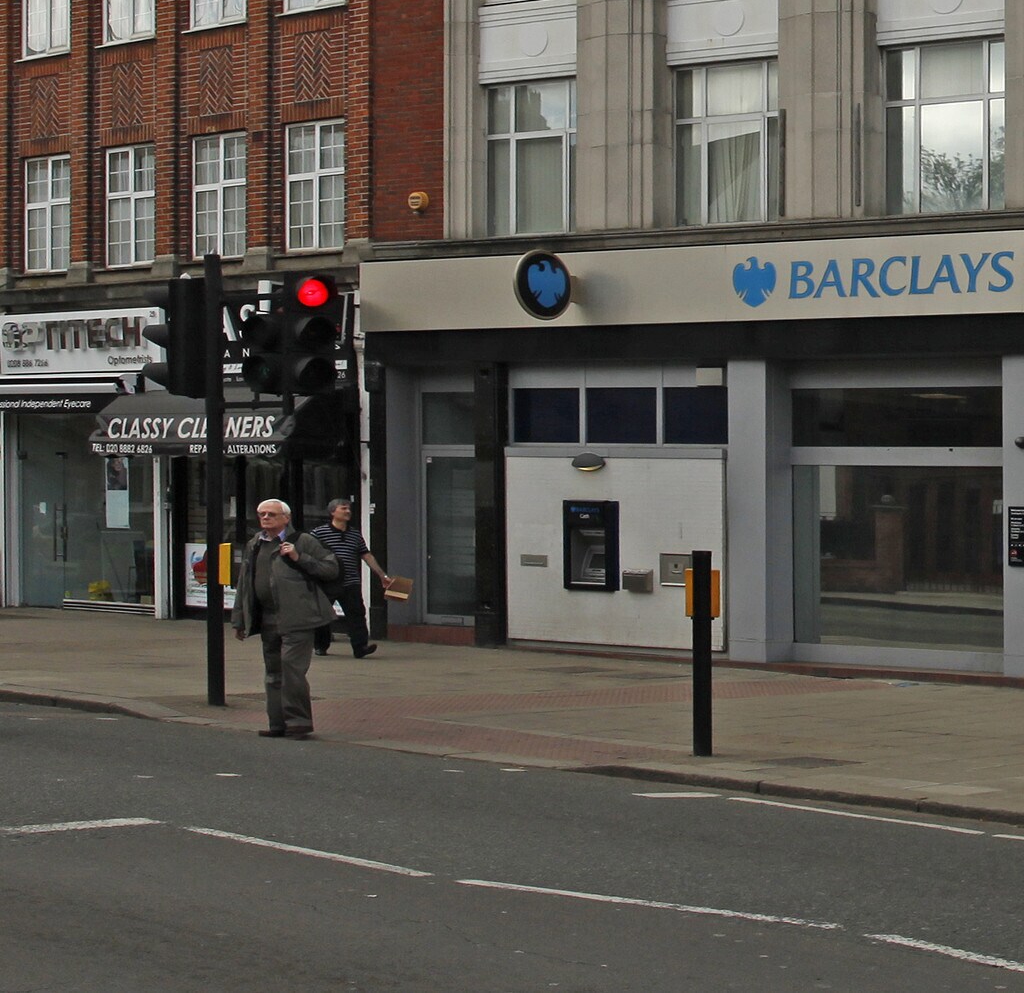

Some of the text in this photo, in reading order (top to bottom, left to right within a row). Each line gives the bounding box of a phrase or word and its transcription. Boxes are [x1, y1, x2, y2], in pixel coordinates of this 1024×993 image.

[788, 251, 1014, 300] BARCLAYS
[63, 399, 92, 409] Eyecare
[107, 415, 276, 439] CLASSY CLENERS
[106, 443, 118, 453] 020
[119, 444, 136, 453] 8882
[227, 444, 277, 454] ALTERATIONS
